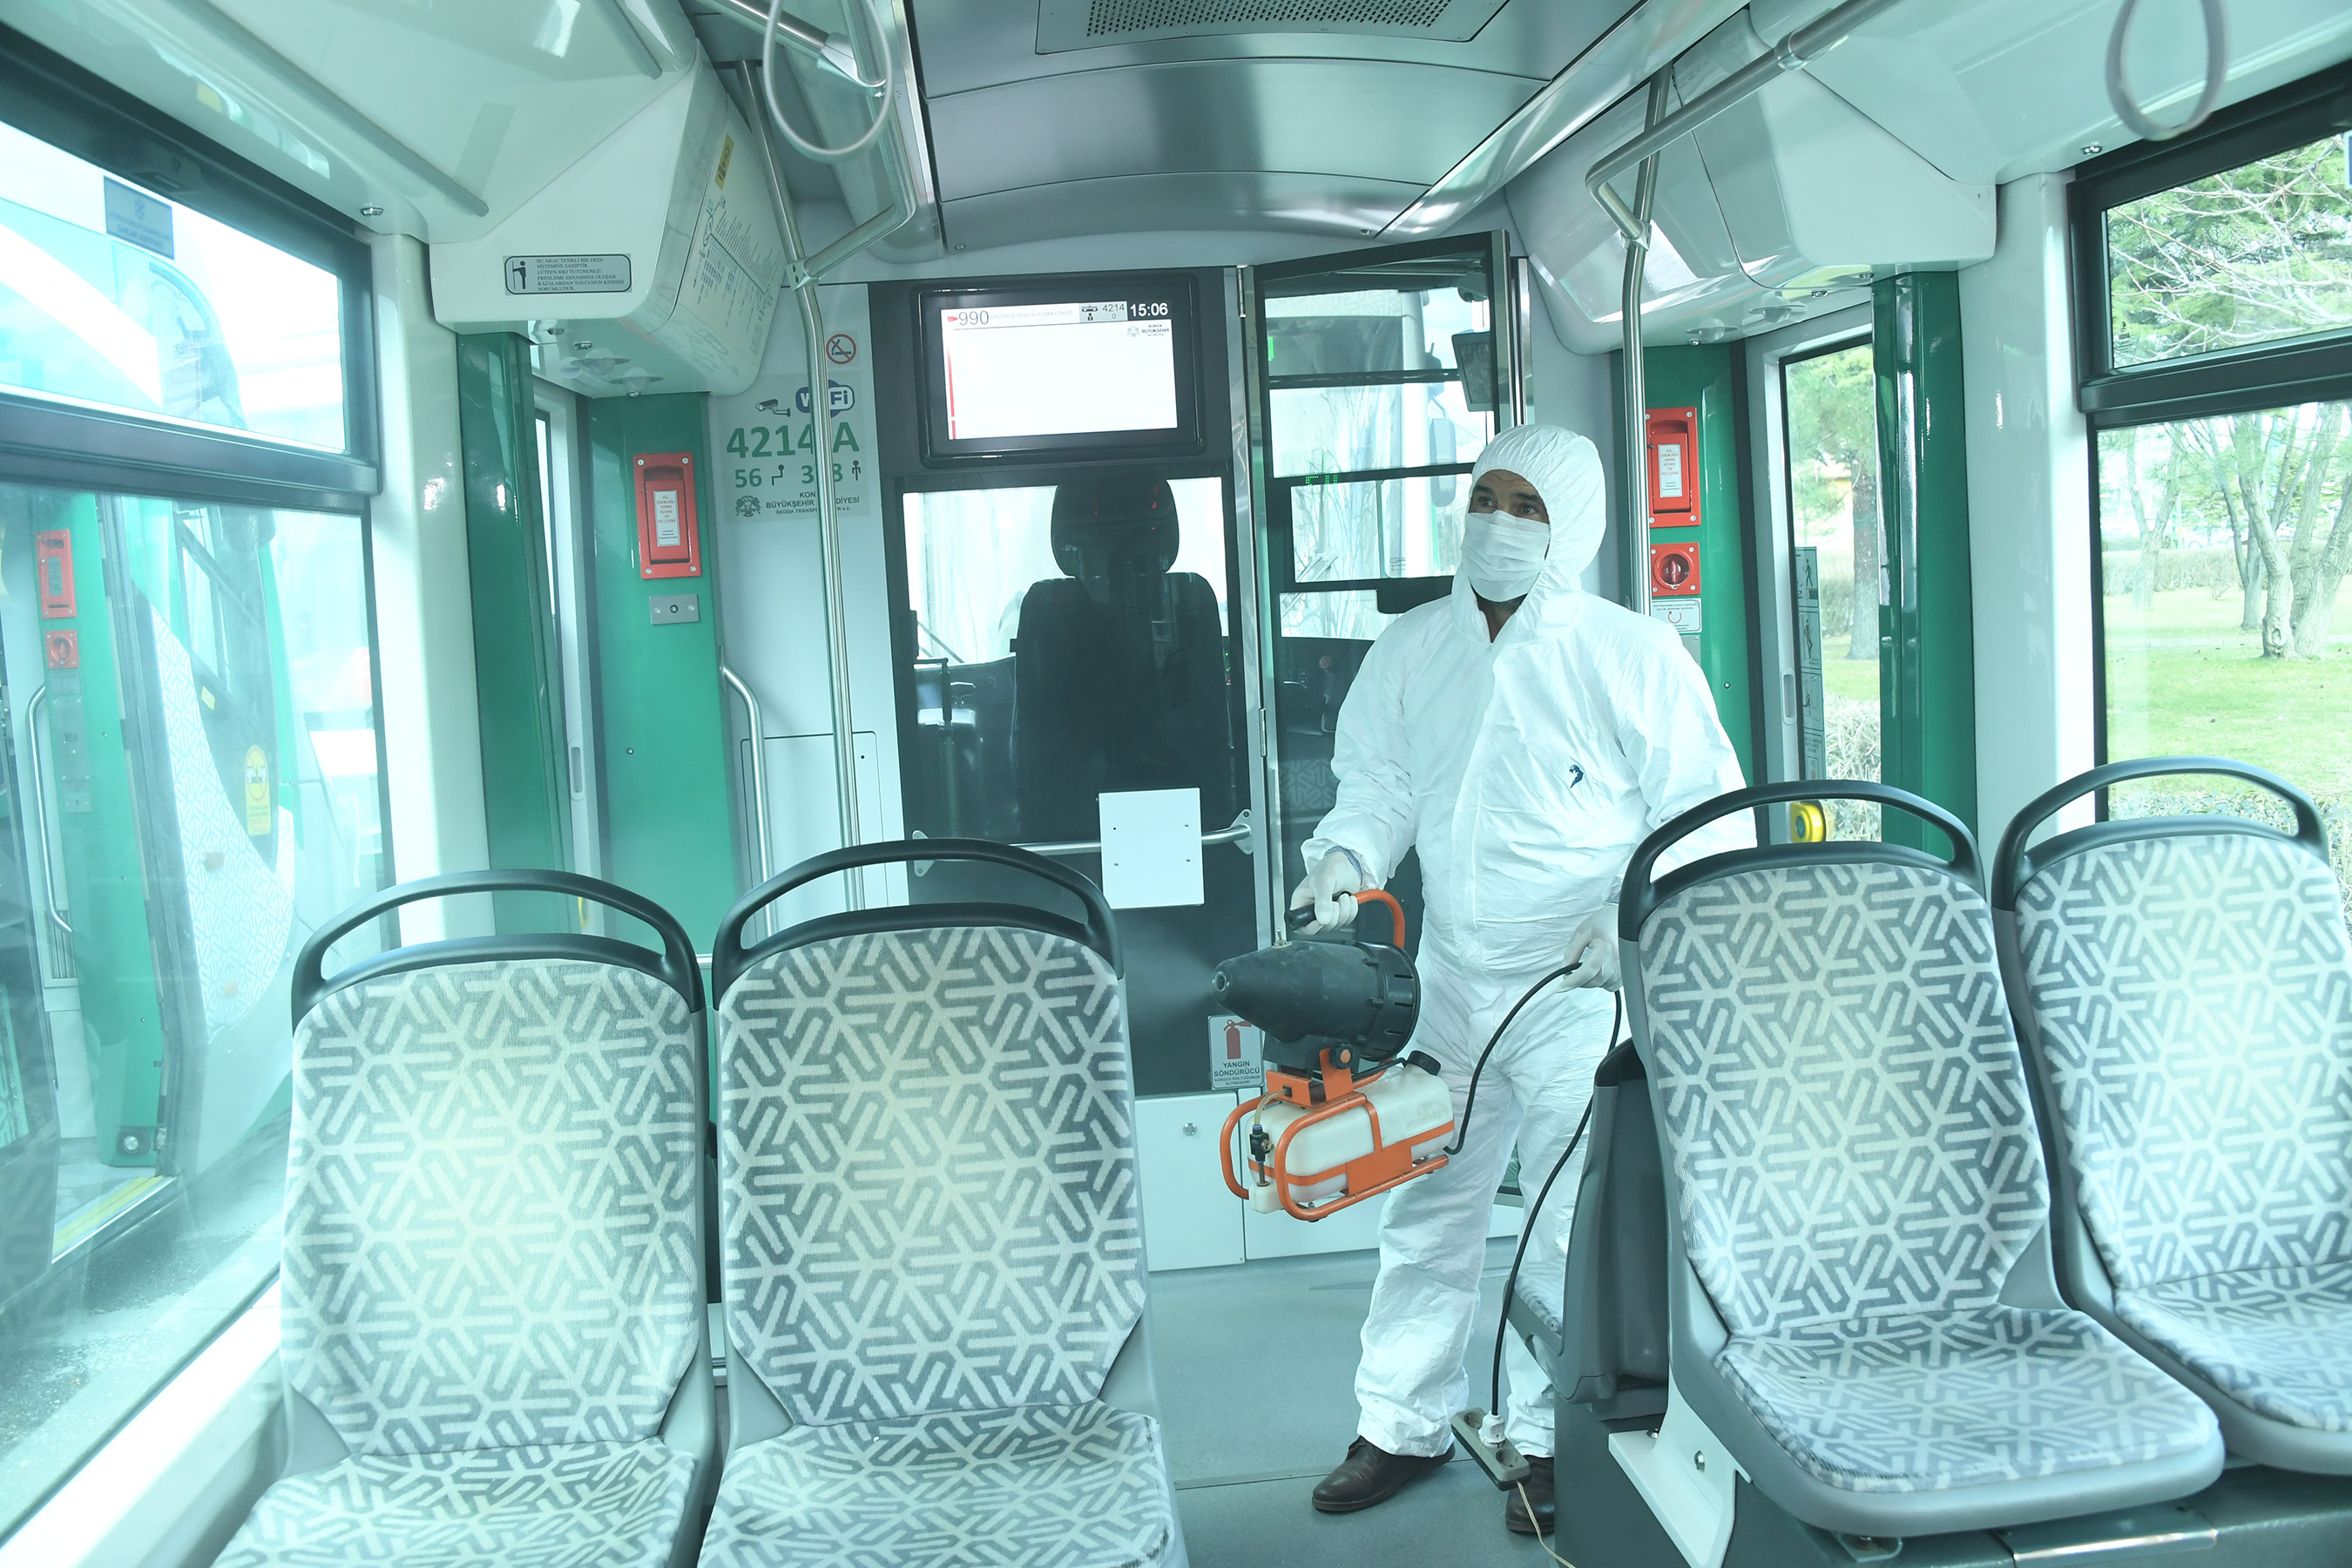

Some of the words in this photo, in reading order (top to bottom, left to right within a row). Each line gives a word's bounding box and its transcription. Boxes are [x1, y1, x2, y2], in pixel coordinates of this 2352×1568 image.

[1102, 303, 1125, 312] 4214
[1130, 302, 1168, 317] 15:06
[958, 310, 989, 326] 990
[734, 468, 762, 488] 56
[801, 463, 843, 484] 38
[766, 499, 814, 510] BÜYÜKŞEHİR
[1213, 1067, 1260, 1077] SÖNDÜRÜCÜ
